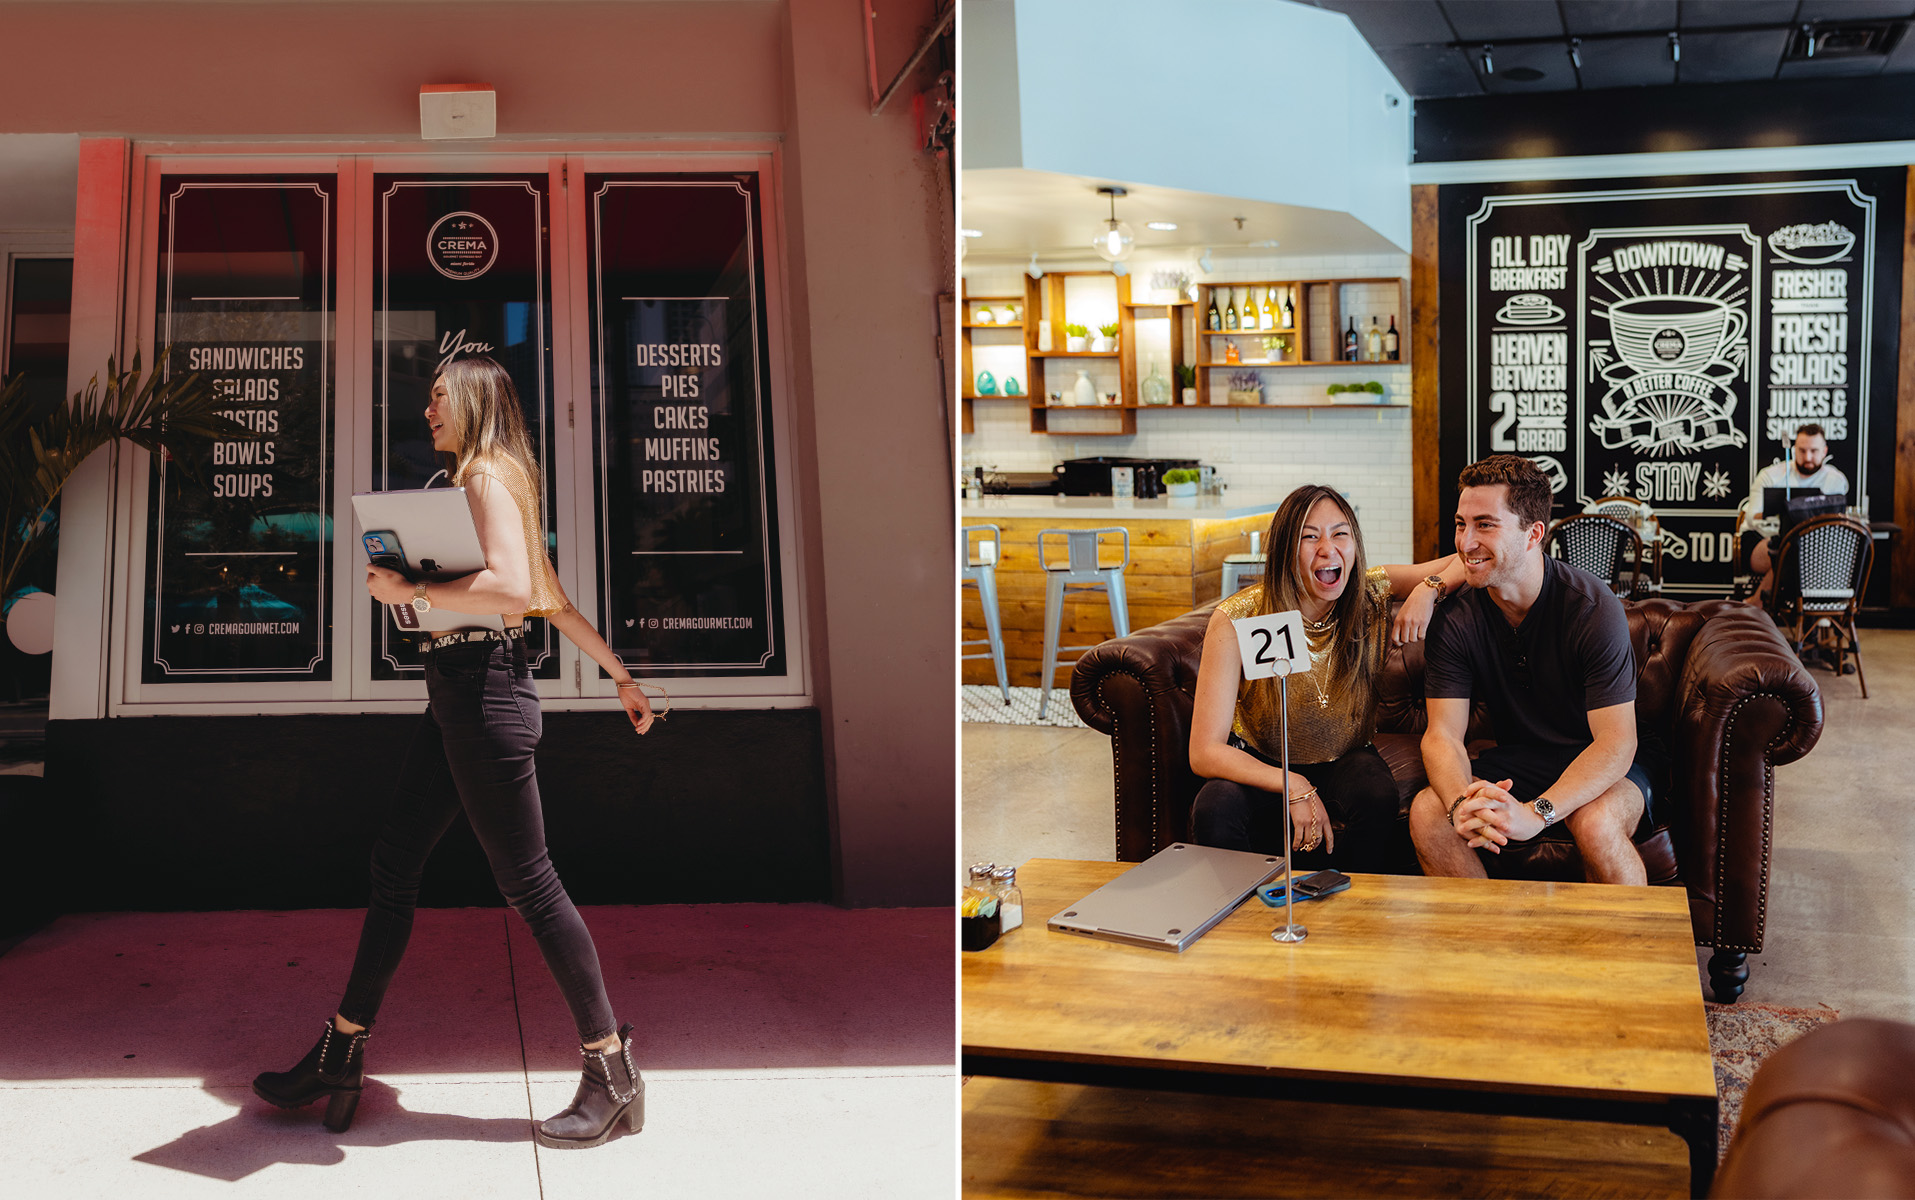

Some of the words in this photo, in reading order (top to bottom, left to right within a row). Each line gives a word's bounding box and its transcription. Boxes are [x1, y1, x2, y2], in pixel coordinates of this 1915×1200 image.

[437, 240, 487, 250] CREMA
[1490, 236, 1527, 268] ALL
[1529, 234, 1571, 267] DAY
[1612, 240, 1725, 273] DOWNTOWN
[1490, 266, 1568, 291] BREAKFAST
[1771, 268, 1848, 299] FRESHER
[1771, 313, 1848, 354] FRESH
[189, 346, 304, 370] SANDWICHES
[434, 328, 495, 374] You
[636, 343, 722, 367] DESSERTS
[1490, 333, 1568, 366] HEAVEN
[1490, 365, 1568, 391] BETWEEN
[1769, 353, 1848, 386] SALADS
[661, 374, 699, 398] PIES
[1622, 384, 1634, 399] A
[1632, 374, 1673, 395] BETTER
[1674, 374, 1717, 399] COFFEE
[1516, 392, 1568, 416] SLICES
[1766, 388, 1830, 418] JUICES
[1831, 388, 1848, 418] &
[653, 405, 709, 429] CAKES
[1488, 391, 1517, 452] 2
[213, 441, 275, 465] BOWLS
[645, 437, 720, 461] MUFFINS
[1516, 429, 1567, 452] BREAD
[213, 473, 273, 498] SOUPS
[642, 469, 725, 493] PASTRIES
[1635, 461, 1702, 501] STAY
[1688, 531, 1715, 563] TO
[208, 622, 300, 635] CREMAGOURMET.COM
[662, 616, 753, 630] CREMAGOURMET.COM
[1251, 624, 1295, 665] 21
